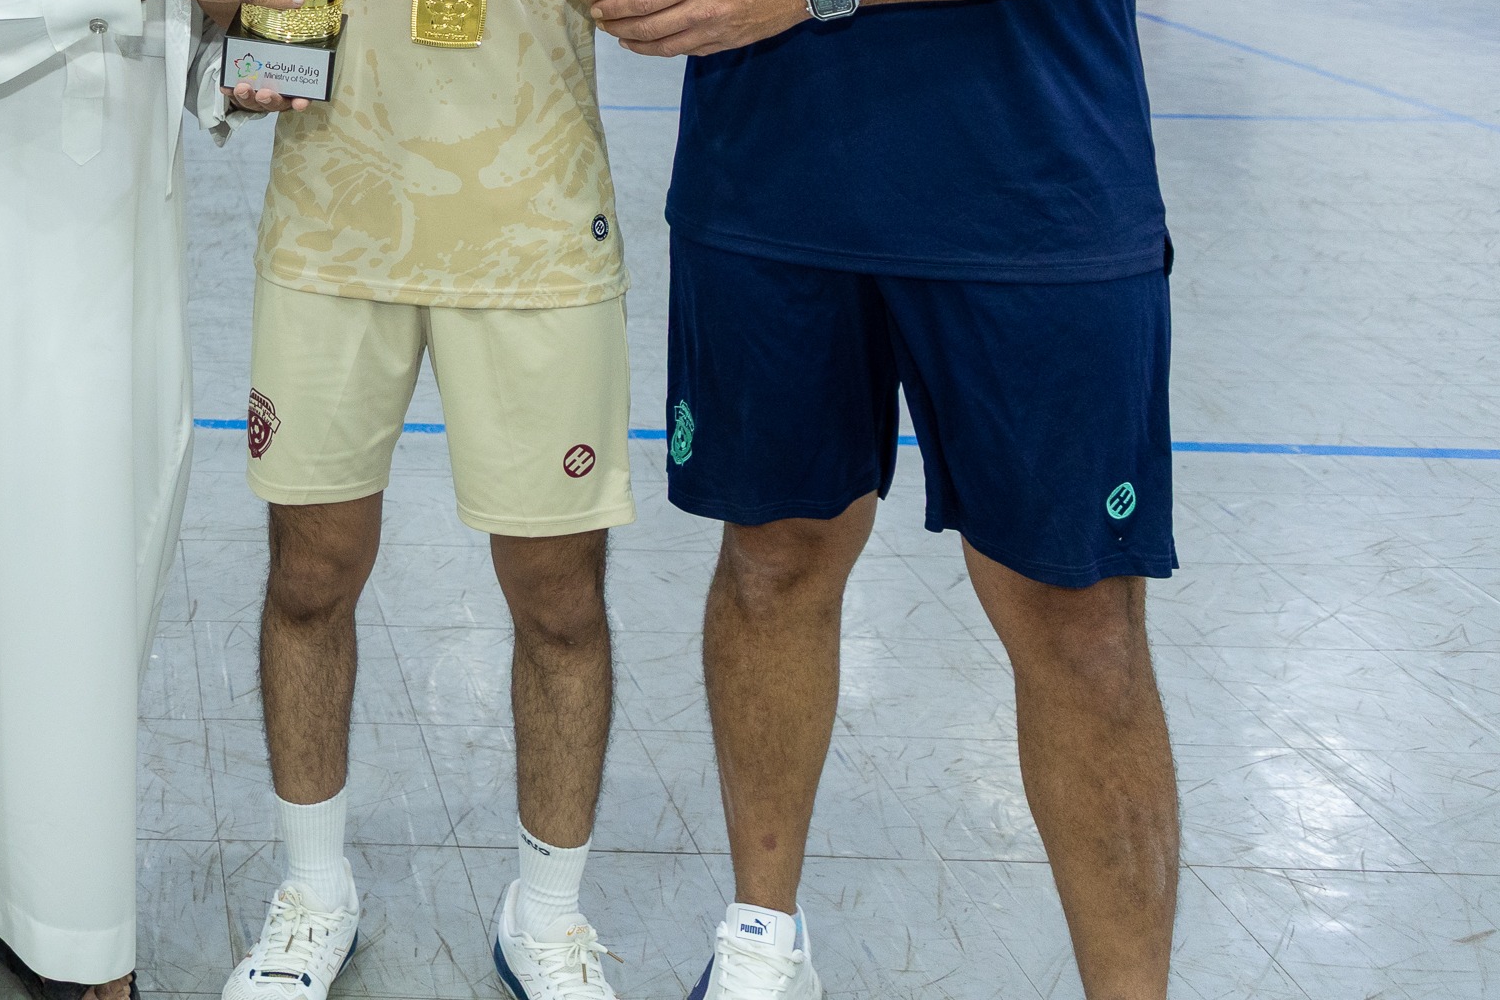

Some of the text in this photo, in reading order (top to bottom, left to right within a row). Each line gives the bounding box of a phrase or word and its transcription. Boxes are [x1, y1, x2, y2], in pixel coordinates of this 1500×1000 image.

[265, 61, 320, 77] وزارة الرياضة
[263, 71, 289, 82] Ministry
[299, 76, 319, 85] Sport
[740, 923, 763, 936] PUMA
